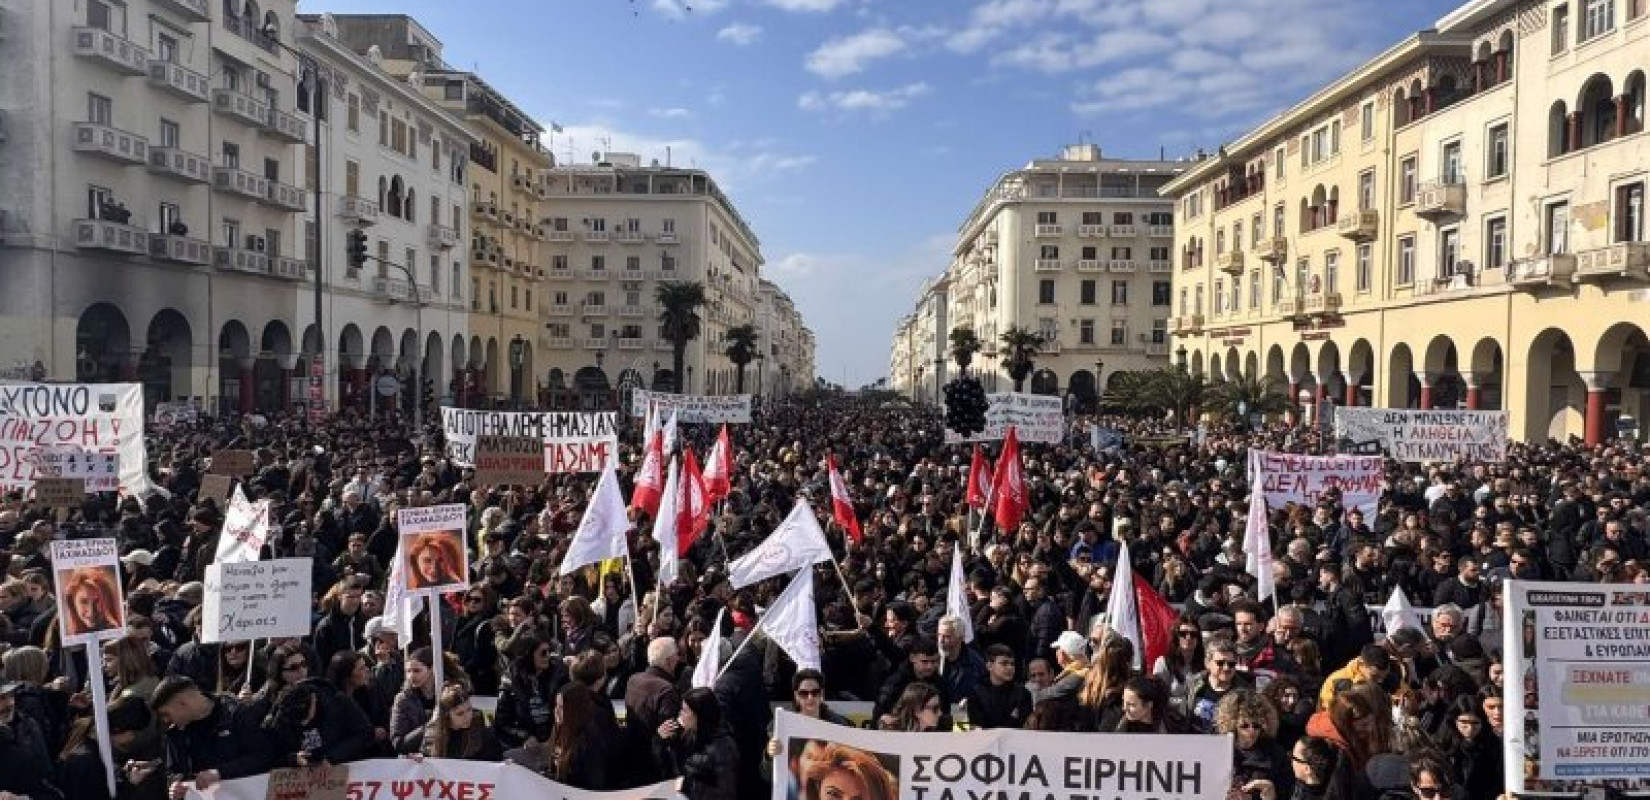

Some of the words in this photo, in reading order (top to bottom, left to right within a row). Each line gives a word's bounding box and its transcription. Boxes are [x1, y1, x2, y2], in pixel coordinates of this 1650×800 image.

[0, 386, 89, 416] ΥΓΟΝΟ
[1384, 411, 1407, 425] ΔΕΝ
[1554, 610, 1611, 623] ΦΑΙΝΕΤΑΙ
[1615, 611, 1636, 623] ΟΤΙ
[1544, 626, 1621, 640] ΕΞΕΤΑΣΤΙΚΕΣ
[1573, 670, 1630, 684] ΞΕΧΝΑΤΕ
[1577, 731, 1597, 743] ΜΙΑ
[911, 753, 1049, 786] ΣΟΦΙΑ
[1063, 757, 1201, 794] ΕΙΡΗΝΗ
[346, 781, 373, 800] 57
[391, 779, 496, 800] ΨΥΧΕΣ
